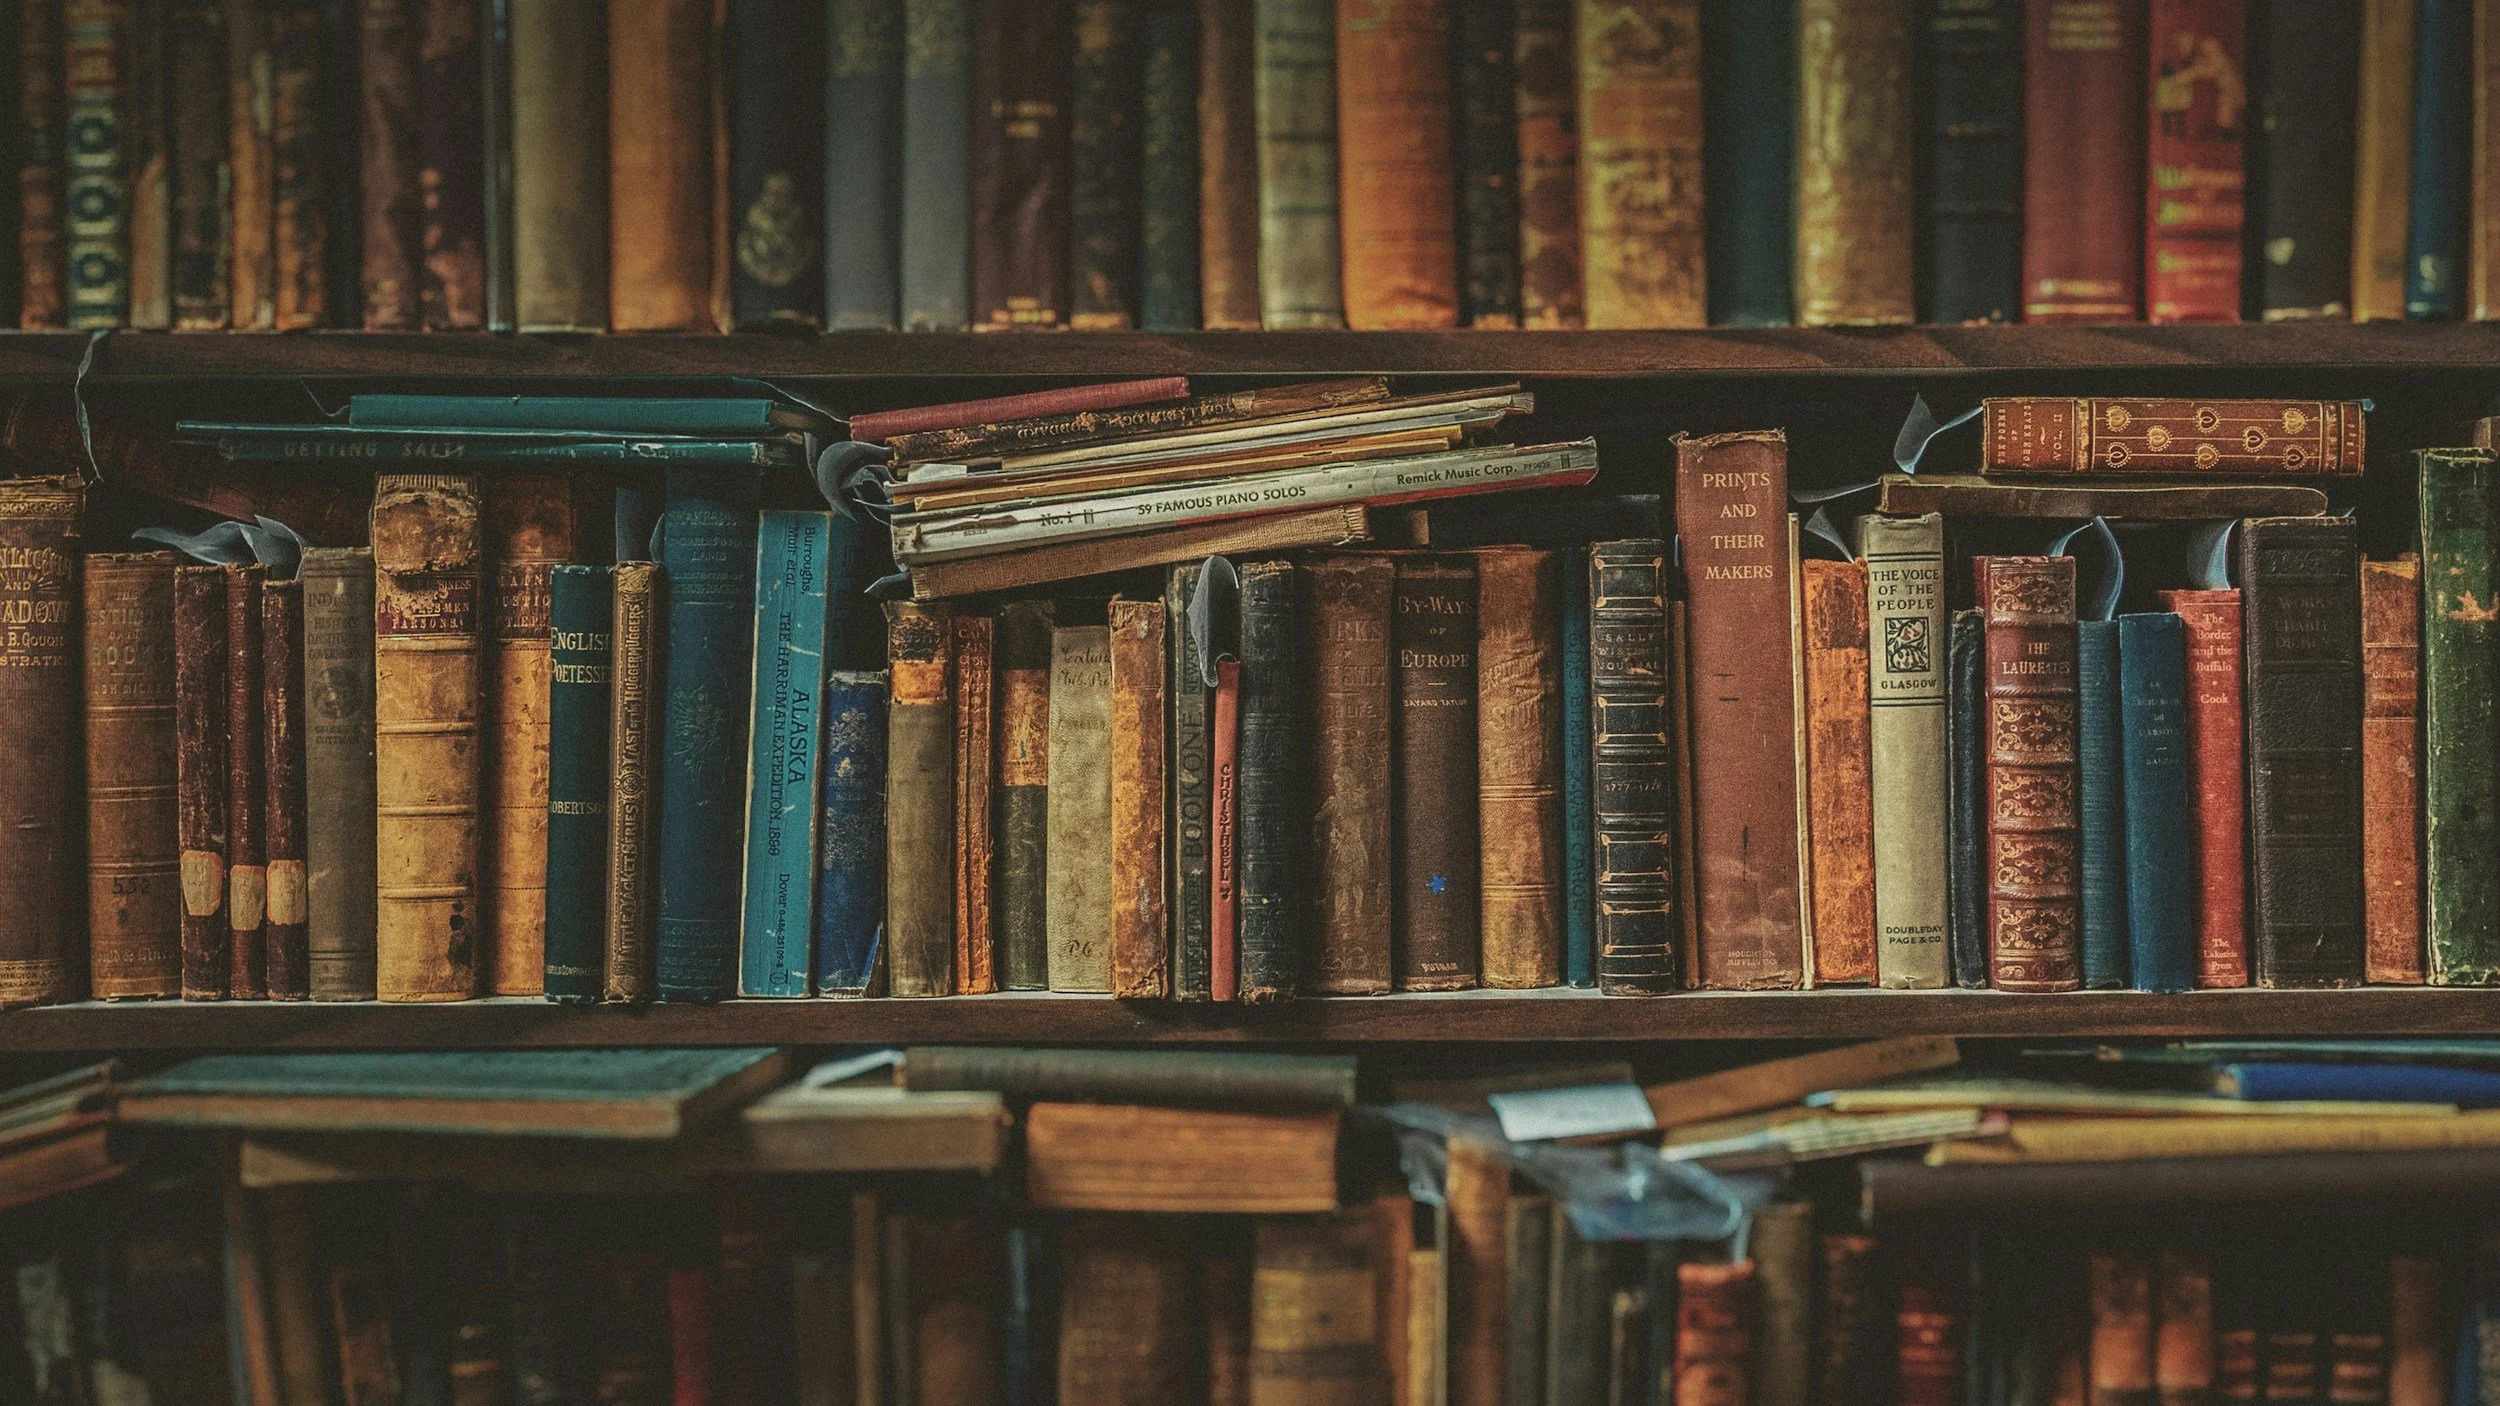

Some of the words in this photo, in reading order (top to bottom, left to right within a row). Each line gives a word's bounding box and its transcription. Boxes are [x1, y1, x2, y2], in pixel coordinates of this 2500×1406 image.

[1998, 408, 2006, 441] POEMS
[2023, 405, 2032, 437] KEATS
[1997, 444, 2006, 464] THE
[1397, 473, 1441, 485] Remick
[1445, 468, 1480, 480] Music
[1484, 463, 1518, 479] Corp.
[1703, 472, 1770, 488] PRINTS
[1138, 503, 1152, 515] 59
[1156, 496, 1212, 513] FAMOUS
[1216, 491, 1259, 507] PIANO
[1264, 485, 1306, 500] SOLOS
[1720, 503, 1757, 518] AND
[786, 526, 799, 553] Muir
[1710, 534, 1765, 549] THEIR
[799, 526, 816, 596] Burroughs,
[1705, 565, 1774, 580] MAKERS
[1872, 570, 1899, 581] THE
[1902, 569, 1939, 580] VOICE
[5, 582, 31, 591] AND
[1879, 585, 1898, 595] OF
[1906, 584, 1934, 594] THE
[0, 600, 71, 623] ADOW
[443, 602, 470, 614] MEN
[1877, 599, 1934, 610] PEOPLE
[2203, 613, 2224, 624] The
[779, 612, 791, 643] THE
[2196, 629, 2232, 640] Border
[1605, 633, 1654, 642] SALLY
[2028, 642, 2051, 655] THE
[2193, 645, 2214, 656] and
[2216, 645, 2233, 656] the
[0, 655, 67, 667] STRATE
[1401, 649, 1469, 669] EUROPE
[2196, 661, 2232, 672] Buffalo
[551, 659, 612, 684] POETESSE
[2002, 661, 2071, 675] LAUREATES
[774, 646, 790, 732] HARRIMAN
[1881, 679, 1937, 690] GLASGOW
[2201, 693, 2229, 704] Cook
[788, 688, 810, 785] ALASKA
[1182, 711, 1203, 771] ONE
[549, 801, 602, 815] OBERTSO
[1182, 780, 1203, 858] BOOK
[1219, 764, 1232, 882] CHRISTABEL
[767, 825, 782, 857] 1899
[777, 873, 790, 907] Dover
[1886, 925, 1943, 934] DOUBLEDAY
[1889, 937, 1917, 945] PAGE
